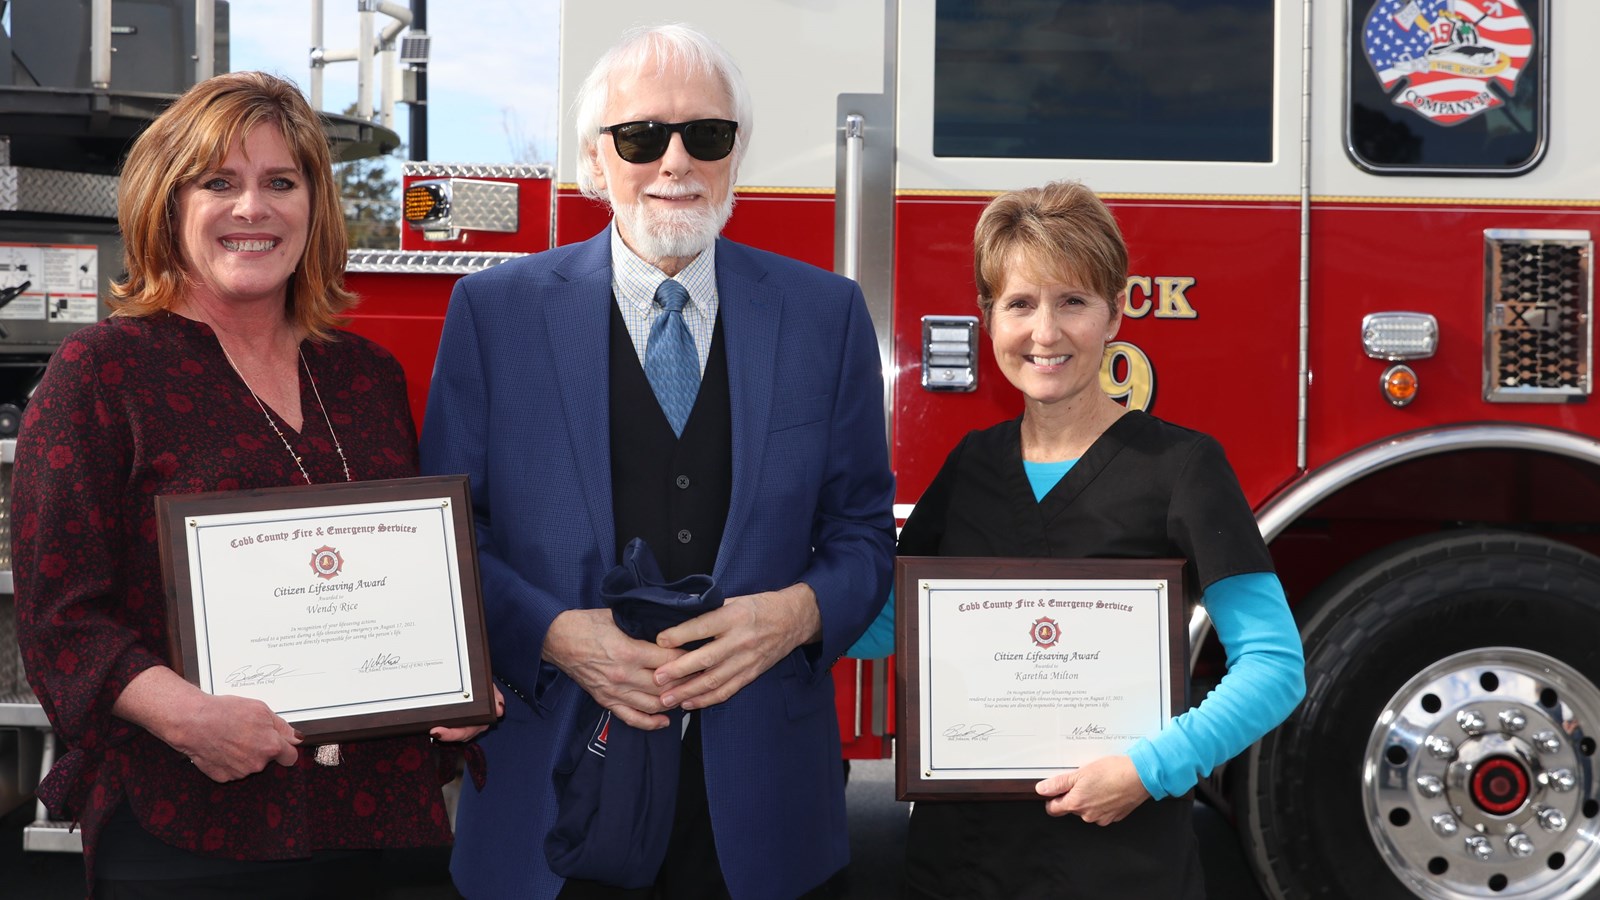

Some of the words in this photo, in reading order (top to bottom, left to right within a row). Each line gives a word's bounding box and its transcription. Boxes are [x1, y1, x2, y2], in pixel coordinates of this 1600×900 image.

[1430, 23, 1451, 44] 19
[1405, 90, 1475, 114] COMPANY
[1123, 276, 1198, 319] CK
[1508, 306, 1558, 326] XT
[1099, 341, 1156, 412] 9
[230, 536, 254, 548] Cobb
[256, 532, 288, 543] County
[292, 529, 312, 540] Fire
[316, 527, 324, 536] &
[327, 526, 375, 535] Emergency
[378, 524, 417, 533] Services
[274, 584, 305, 597] Citizen
[308, 582, 354, 595] Lifesaving
[356, 576, 387, 590] Award
[306, 602, 338, 615] Wendy
[340, 601, 358, 612] Rice
[959, 602, 980, 612] Cobb
[983, 600, 1012, 609] County
[1015, 599, 1035, 609] Fire
[1037, 599, 1045, 607] &
[1048, 599, 1094, 609] Emergency
[1096, 600, 1133, 612] Services
[994, 652, 1023, 661] Citizen
[1026, 651, 1068, 663] Lifesaving
[1070, 650, 1101, 661] Award
[1015, 671, 1048, 681] Karetha
[1050, 670, 1078, 680] Milton
